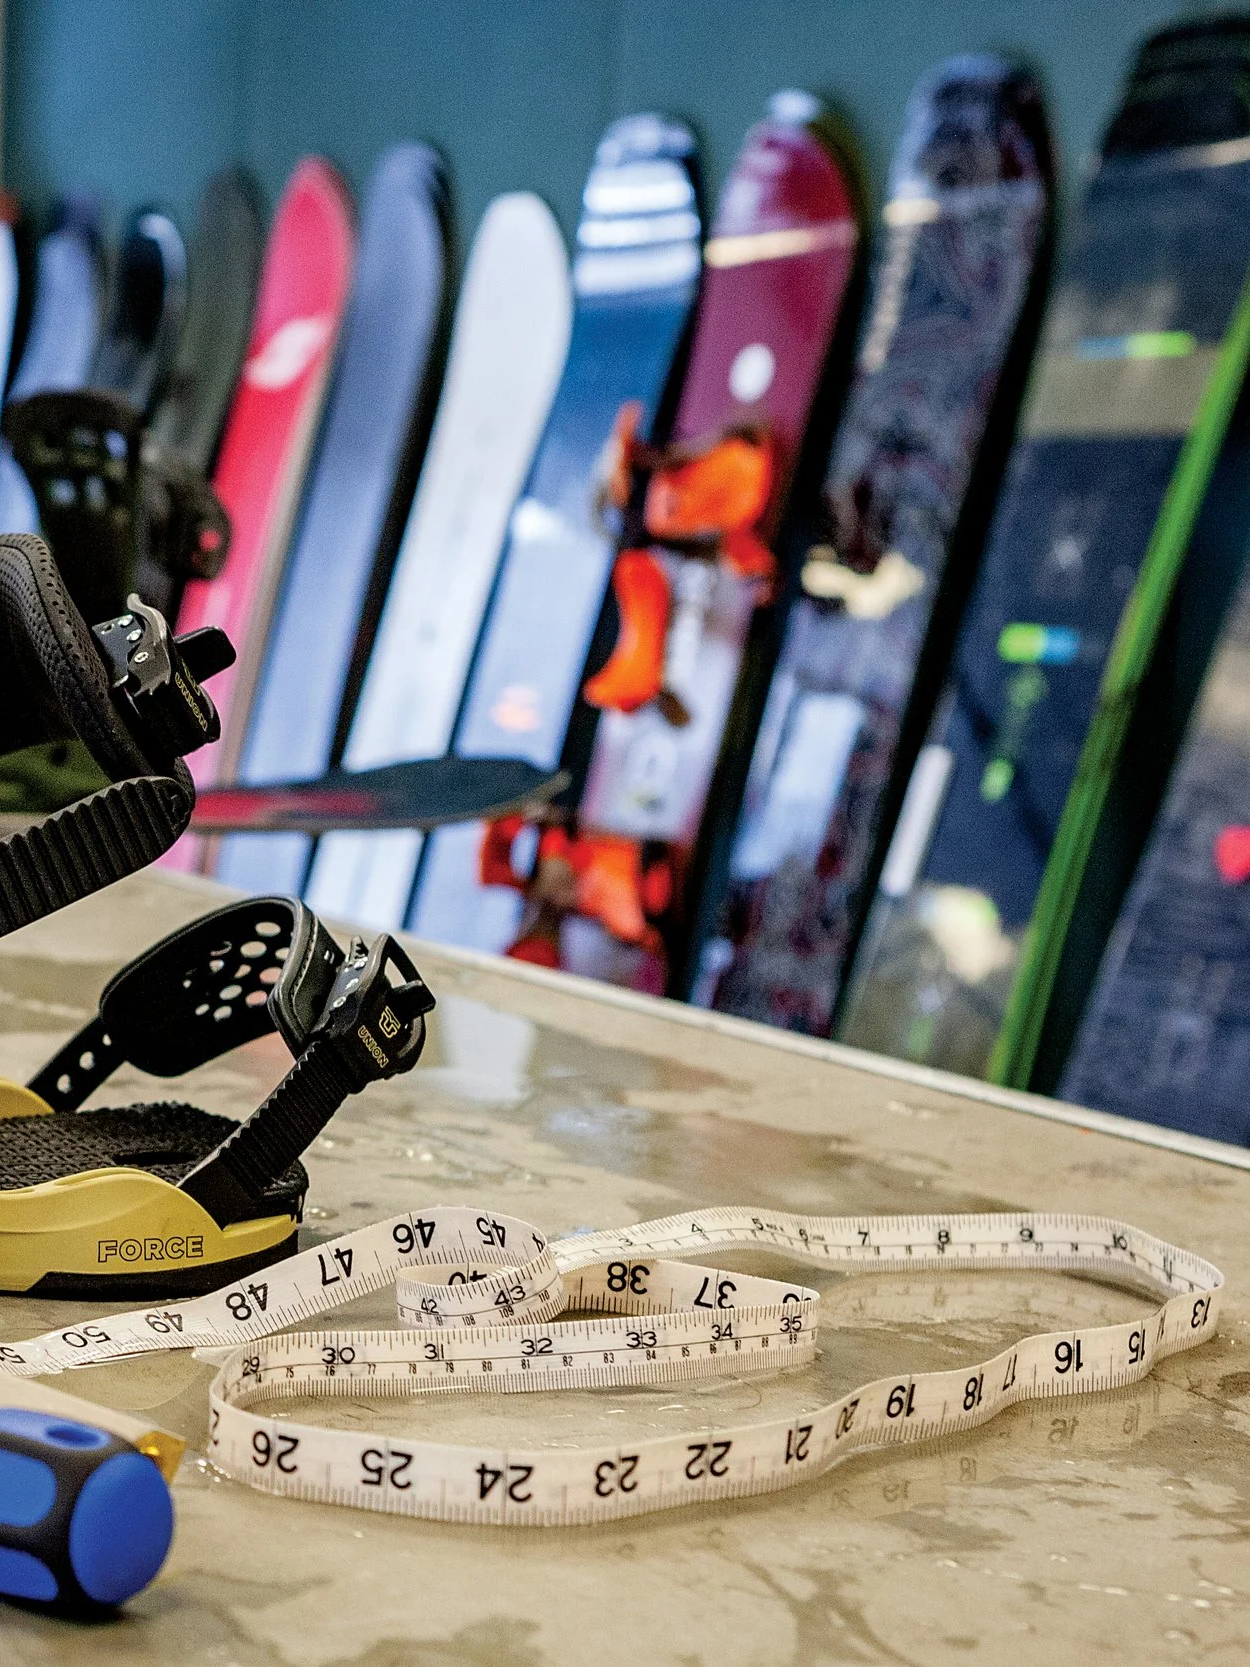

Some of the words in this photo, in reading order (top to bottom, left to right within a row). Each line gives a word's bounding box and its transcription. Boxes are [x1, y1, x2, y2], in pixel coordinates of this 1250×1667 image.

[357, 1024, 389, 1068] UNION
[97, 1235, 205, 1263] FORCE
[393, 1218, 435, 1254] 46
[476, 1217, 506, 1248] 45
[857, 1231, 868, 1246] 7
[938, 1229, 950, 1245] 8
[1019, 1228, 1033, 1243] 9
[1112, 1233, 1128, 1250] 10
[318, 1247, 353, 1286] 47
[607, 1262, 650, 1295] 38
[225, 1283, 269, 1321] 48
[420, 1297, 439, 1314] 42
[494, 1286, 526, 1306] 43
[462, 1315, 476, 1326] 108
[499, 1306, 515, 1319] 109
[538, 1290, 550, 1303] 110
[694, 1277, 737, 1309] 37
[145, 1312, 183, 1334] 49
[1191, 1296, 1211, 1328] 13
[62, 1326, 112, 1348] 50
[242, 1356, 260, 1377] 29
[321, 1346, 355, 1364] 30
[424, 1343, 445, 1359] 31
[521, 1337, 553, 1356] 32
[626, 1331, 657, 1348] 33
[711, 1322, 733, 1340] 34
[780, 1315, 802, 1332] 35
[325, 1365, 335, 1376] 76
[408, 1364, 417, 1374] 78
[482, 1361, 492, 1372] 80
[521, 1359, 530, 1369] 81
[563, 1356, 573, 1367] 82
[603, 1353, 614, 1363] 83
[646, 1350, 656, 1360] 84
[789, 1334, 798, 1344] 89
[1128, 1329, 1145, 1364] 15
[1002, 1353, 1017, 1391] 17
[1055, 1339, 1083, 1374] 16
[886, 1383, 916, 1418] 19
[963, 1373, 984, 1411] 18
[252, 1430, 299, 1473] 26
[685, 1441, 732, 1480] 22
[785, 1425, 813, 1464] 21
[361, 1449, 413, 1489] 25
[476, 1462, 533, 1502] 24
[595, 1455, 639, 1497] 23
